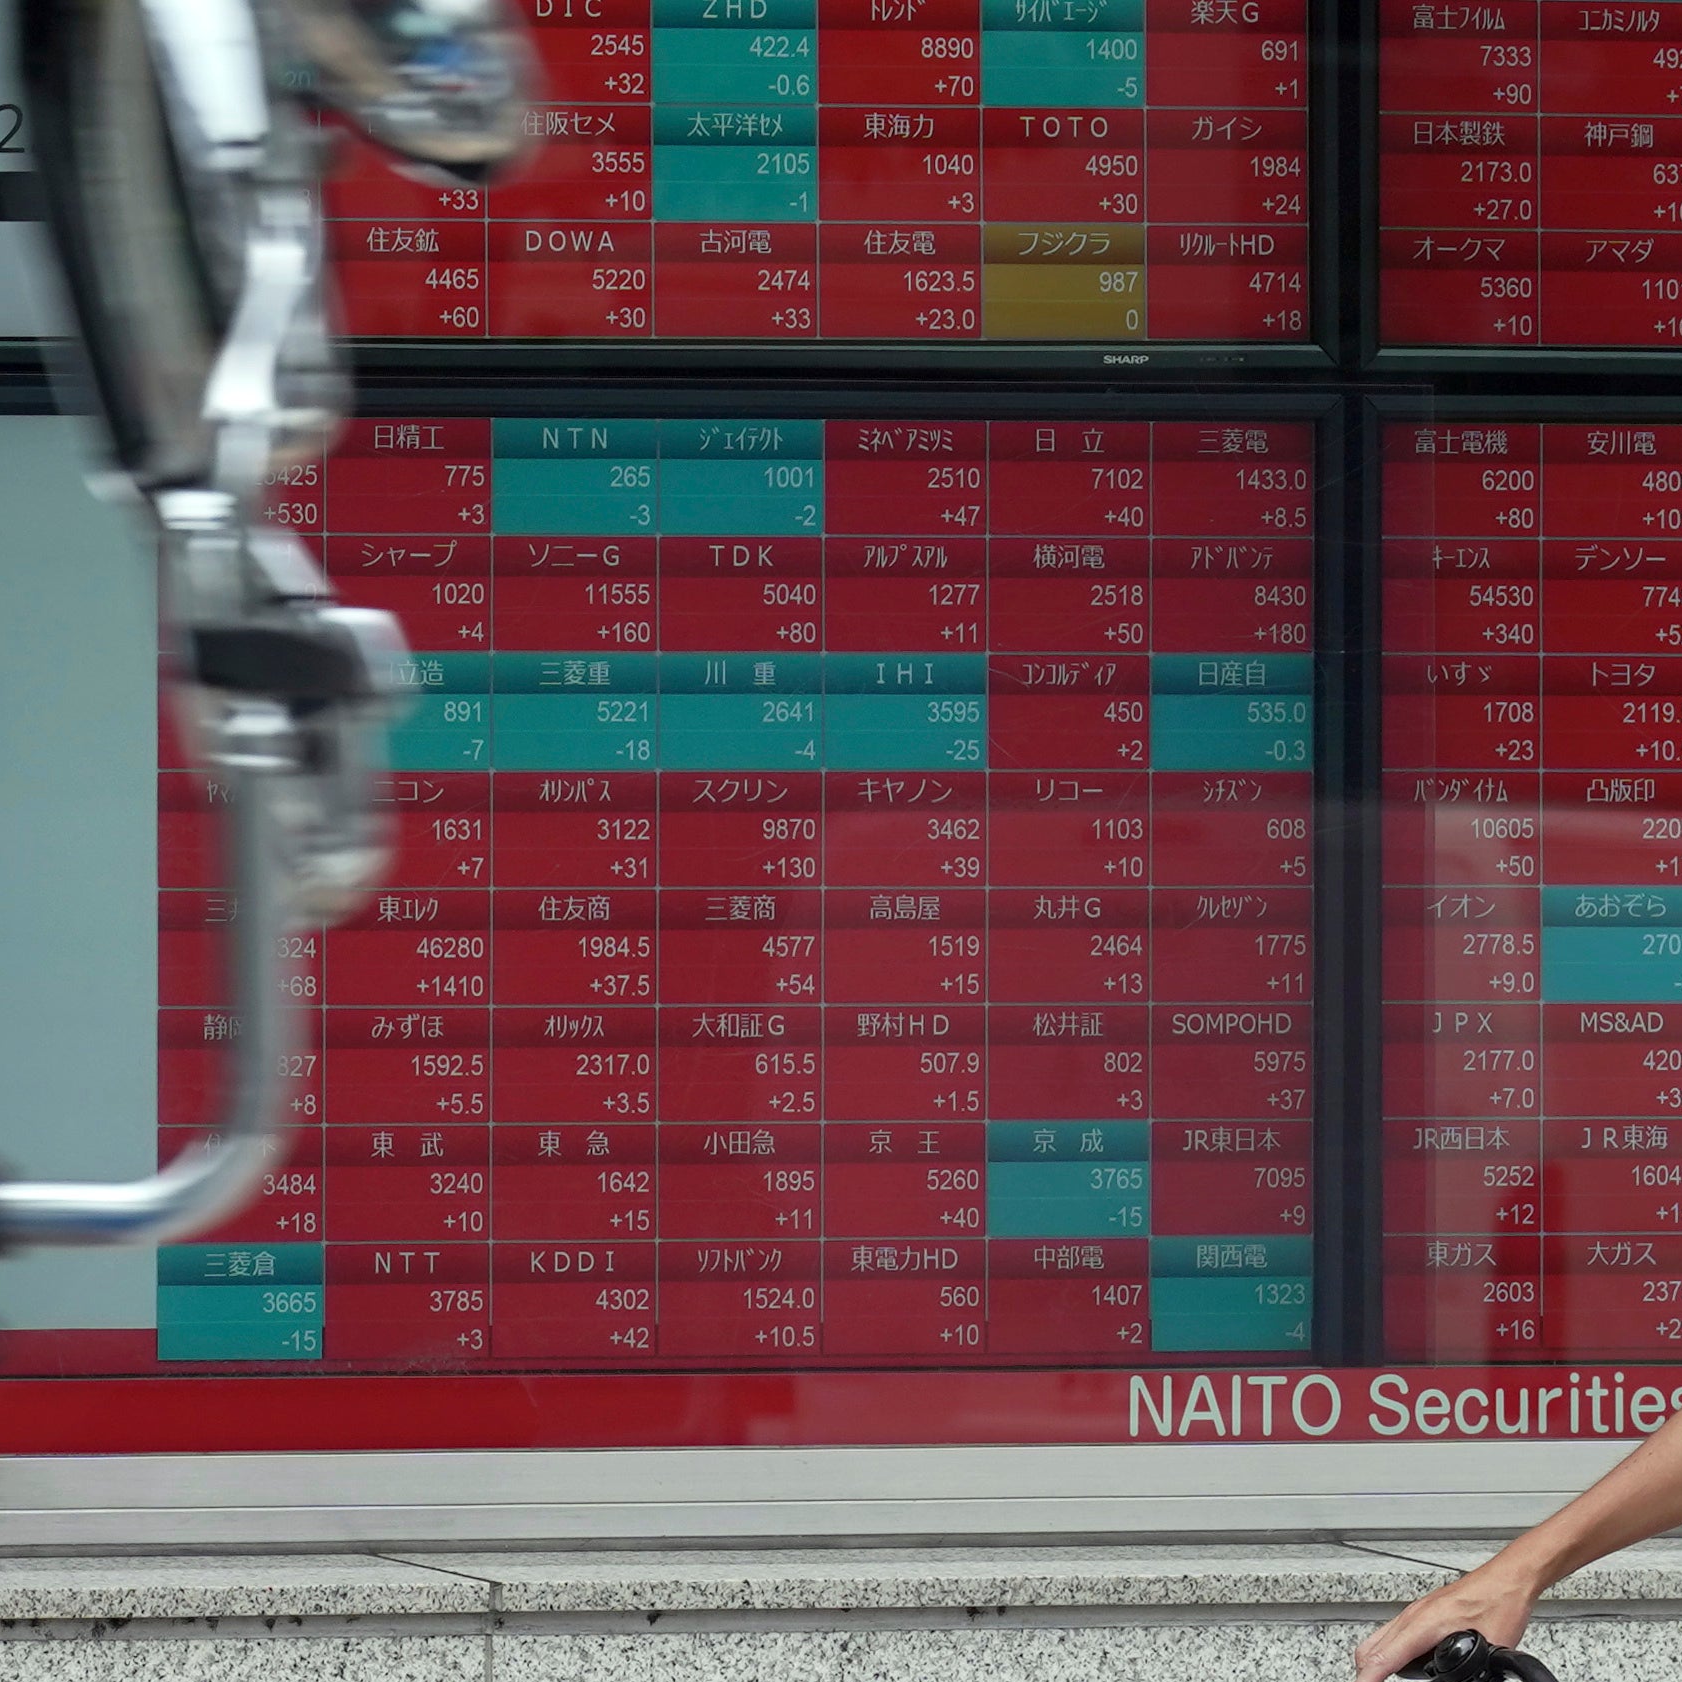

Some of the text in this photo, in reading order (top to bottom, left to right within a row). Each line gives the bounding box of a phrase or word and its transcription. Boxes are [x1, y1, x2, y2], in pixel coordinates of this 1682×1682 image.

[590, 33, 644, 56] 2545
[749, 35, 810, 58] 422.4
[921, 36, 974, 59] 8890
[1086, 38, 1138, 61] 1400
[1261, 39, 1298, 62] 691
[1479, 45, 1532, 67] 7333
[934, 75, 974, 97] +70
[1191, 115, 1262, 141] ガイシ
[1414, 120, 1506, 146] 日本製鉄
[756, 152, 810, 175] 2105
[922, 153, 974, 176] 1040
[1085, 154, 1138, 177] 4950
[438, 189, 479, 211] +33
[605, 189, 646, 212] +10
[863, 229, 936, 255] 住友電
[1586, 237, 1655, 264] アマダ
[425, 268, 479, 290] 4465
[757, 269, 811, 291] 2474
[1099, 270, 1139, 293] 987
[1248, 271, 1302, 293] 4714
[1480, 276, 1532, 299] 5360
[1102, 354, 1150, 365] SHARP
[1415, 429, 1508, 455] 富士電機
[444, 464, 485, 487] 775
[927, 467, 981, 489] 2510
[1091, 468, 1144, 490] 7102
[1236, 468, 1307, 490] 1433.0
[794, 504, 816, 527] -2
[1032, 543, 1106, 569] 横河電
[585, 583, 651, 605] 11555
[928, 583, 980, 606] 1277
[1469, 585, 1534, 607] 54530
[457, 621, 485, 643] +4
[1253, 622, 1306, 645] +180
[1198, 659, 1266, 687] 日産自
[1592, 661, 1656, 687] トヨタ
[443, 700, 481, 723] 891
[597, 700, 648, 723] 5221
[762, 700, 813, 723] 2641
[1103, 701, 1143, 723] 450
[1247, 701, 1306, 723] 535.0
[1483, 701, 1535, 723] 1708
[945, 739, 980, 761] -25
[858, 777, 953, 803] キヤノン
[1586, 777, 1655, 803] 凸版印
[432, 818, 481, 841] 1631
[762, 818, 816, 840] 9870
[1092, 818, 1144, 840] 1103
[1266, 818, 1307, 840] 608
[1470, 817, 1534, 839] 10605
[610, 856, 647, 879] +31
[537, 894, 611, 921] 住友商
[870, 893, 941, 921] 高島屋
[415, 936, 484, 959] 46280
[761, 935, 816, 958] 4577
[1254, 934, 1306, 956] 1775
[1103, 972, 1143, 995] +13
[1488, 971, 1535, 993] +9.0
[1032, 1011, 1104, 1038] 松井証
[411, 1054, 484, 1077] 1592.5
[575, 1053, 650, 1076] 2317.0
[920, 1051, 980, 1074] 507.9
[1253, 1050, 1306, 1073] 5975
[290, 1093, 317, 1116] +8
[768, 1091, 816, 1113] +2.5
[703, 1128, 776, 1156] 小田急
[1412, 1125, 1511, 1151] JR西日本
[263, 1173, 317, 1196] 3484
[597, 1171, 650, 1193] 1642
[926, 1169, 979, 1191] 5260
[1090, 1167, 1143, 1190] 3765
[443, 1210, 483, 1232] +10
[1279, 1204, 1306, 1227] +9
[1196, 1243, 1268, 1269] 関西電
[1587, 1240, 1657, 1266] 大ガス
[262, 1291, 317, 1314] 3665
[595, 1288, 650, 1311] 4302
[743, 1287, 815, 1309] 1524.0
[939, 1286, 980, 1307] 560
[1091, 1284, 1143, 1306] 1407
[1483, 1281, 1535, 1303] 2603
[939, 1323, 979, 1346] +10
[1129, 1373, 1343, 1438] NAITO
